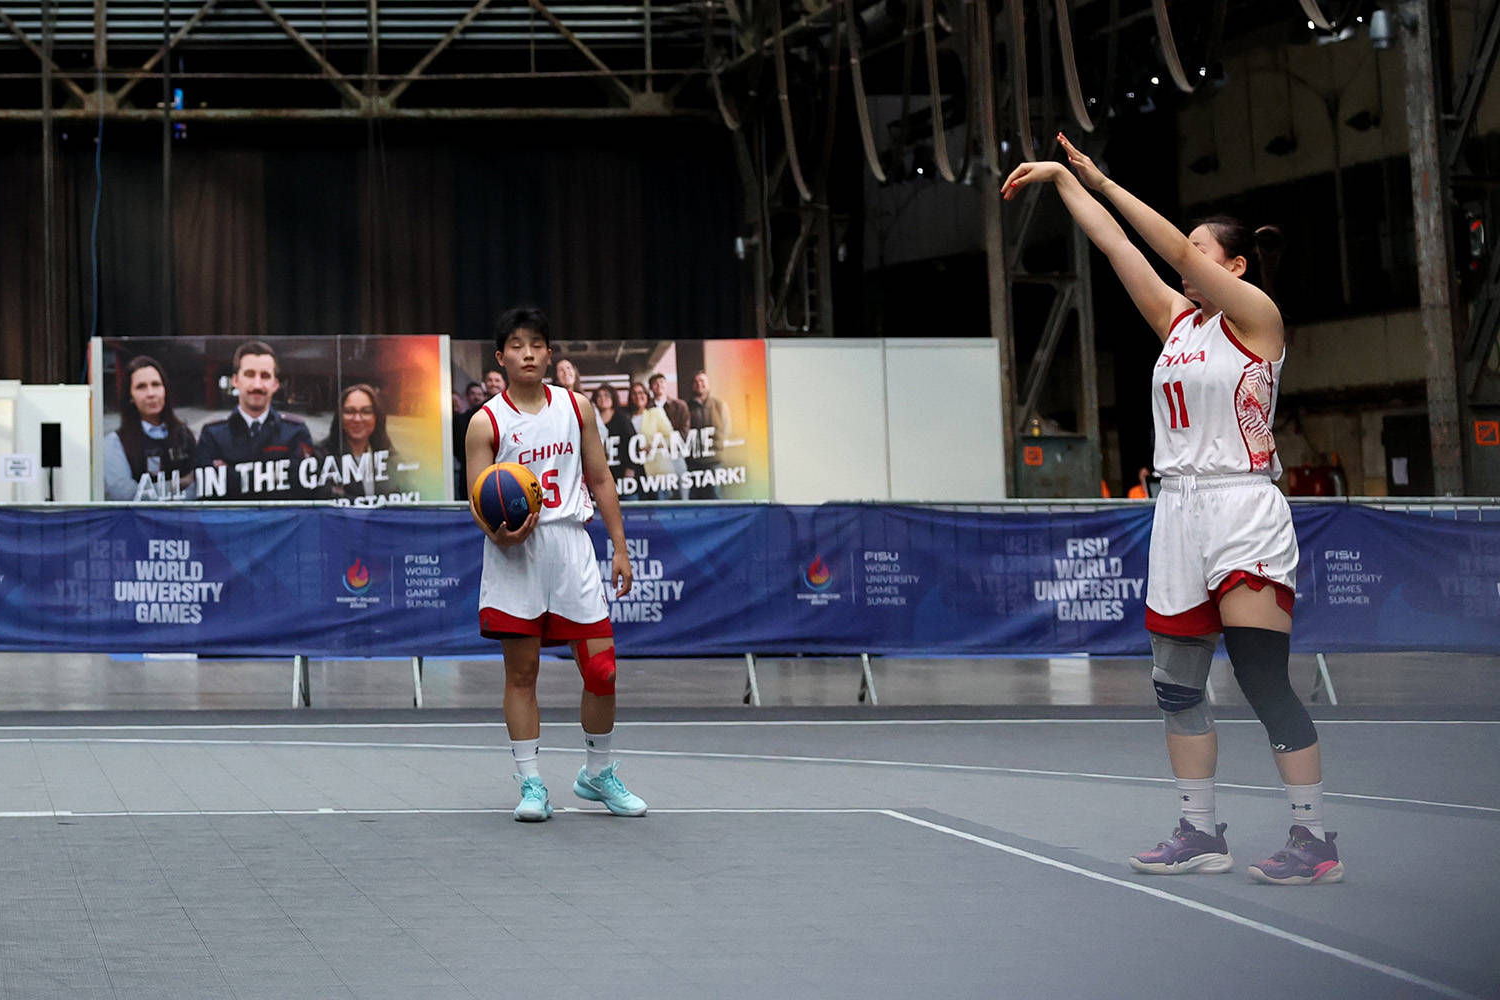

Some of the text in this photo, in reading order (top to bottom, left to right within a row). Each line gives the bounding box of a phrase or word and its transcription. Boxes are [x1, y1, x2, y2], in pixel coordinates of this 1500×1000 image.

[1162, 380, 1190, 429] 11
[518, 442, 574, 465] CHINA
[628, 426, 717, 465] GAME
[135, 469, 186, 500] ALL
[195, 465, 228, 497] IN
[235, 459, 292, 493] THE
[299, 450, 390, 490] GAME
[640, 473, 679, 493] WIR
[681, 466, 747, 490] STARK!
[148, 539, 190, 560] FISU
[606, 539, 649, 559] FSU
[1066, 537, 1110, 558] FISU
[1325, 550, 1360, 560] FISU
[404, 554, 439, 564] FISU
[864, 563, 901, 573] WORLD
[1054, 557, 1123, 579] WORLD
[1326, 562, 1363, 572] WORLD
[135, 560, 203, 581] WORLD
[405, 567, 441, 576] WORLD
[596, 560, 664, 580] WRLD
[865, 575, 920, 584] UNIVERSITY
[1326, 573, 1382, 583] UNIVERSITY
[114, 581, 223, 602] UNIVERSITY
[405, 578, 460, 587] UNIVERSITY
[866, 585, 899, 595] GAMES
[1034, 578, 1144, 601] UNIVERSITY
[1327, 584, 1362, 593] GAMES
[405, 589, 440, 598] GAMES
[1328, 595, 1370, 605] SUMMER
[135, 603, 203, 624] GAMES
[609, 602, 663, 623] AMES
[1057, 600, 1125, 621] GAMES
